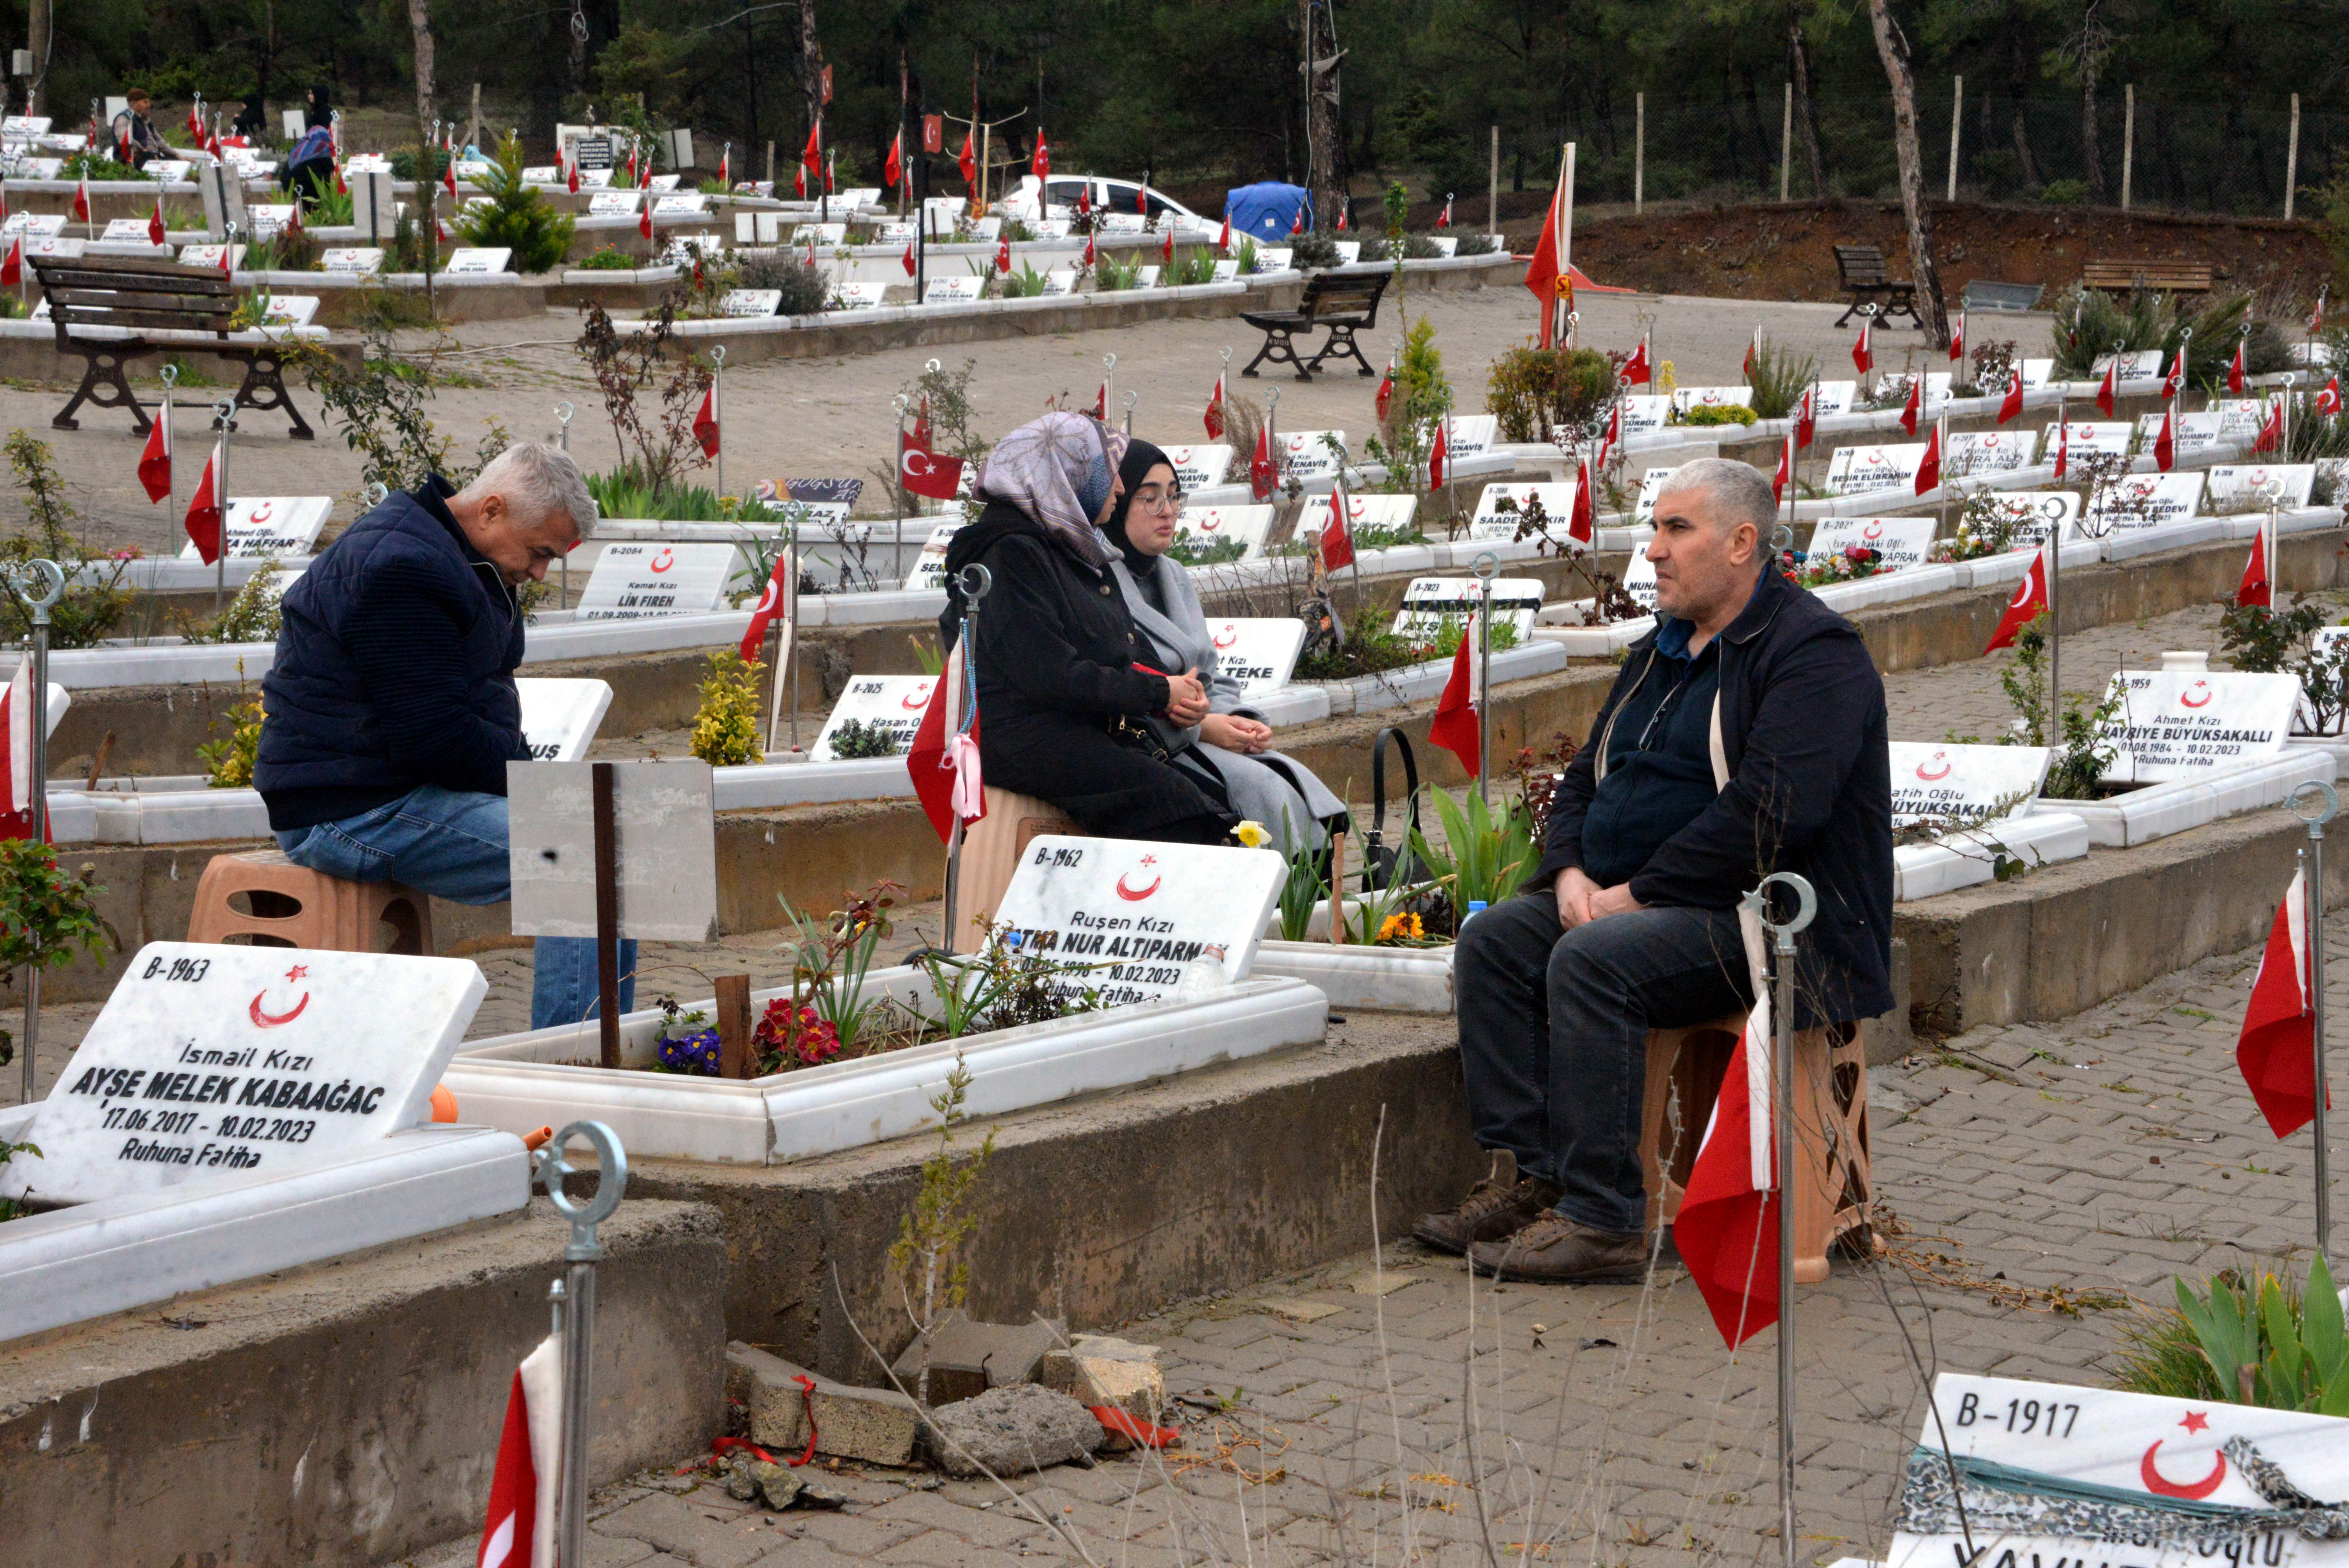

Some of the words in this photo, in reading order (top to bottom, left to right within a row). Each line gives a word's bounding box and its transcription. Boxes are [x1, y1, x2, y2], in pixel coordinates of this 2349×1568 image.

[242, 538, 296, 548] HAFFAR
[1415, 583, 1440, 592] B-2023
[1228, 656, 1247, 665] Kızı
[1225, 667, 1274, 679] TEKE
[852, 682, 884, 694] B-2025
[871, 717, 907, 727] Hasan
[2153, 715, 2194, 725] Ahmet
[2198, 716, 2222, 726] Kızı
[2163, 725, 2273, 743] BÜYÜKSAKALLI
[2186, 744, 2241, 755] 10.02.2023
[2137, 754, 2176, 765] Ruhuna
[2180, 755, 2214, 766] Fatiha
[1891, 788, 1923, 798] atih
[1928, 789, 1965, 802] Oğlu
[1034, 847, 1084, 868] B-1962
[1069, 911, 1132, 931] Ruşen
[1137, 916, 1175, 933] Kızı
[1062, 932, 1105, 955] NUR
[143, 956, 210, 982] B-1963
[1109, 965, 1181, 985] 10.02.2023
[178, 1037, 258, 1068] İsmail
[263, 1049, 314, 1071] Kızı
[142, 1069, 239, 1105] MELEK
[101, 1107, 199, 1134] 17.06.2017
[216, 1115, 316, 1143] 10.02.2023
[118, 1138, 194, 1165] Ruhuna
[196, 1143, 262, 1169] Fatiha
[1957, 1392, 2080, 1438] B-1917
